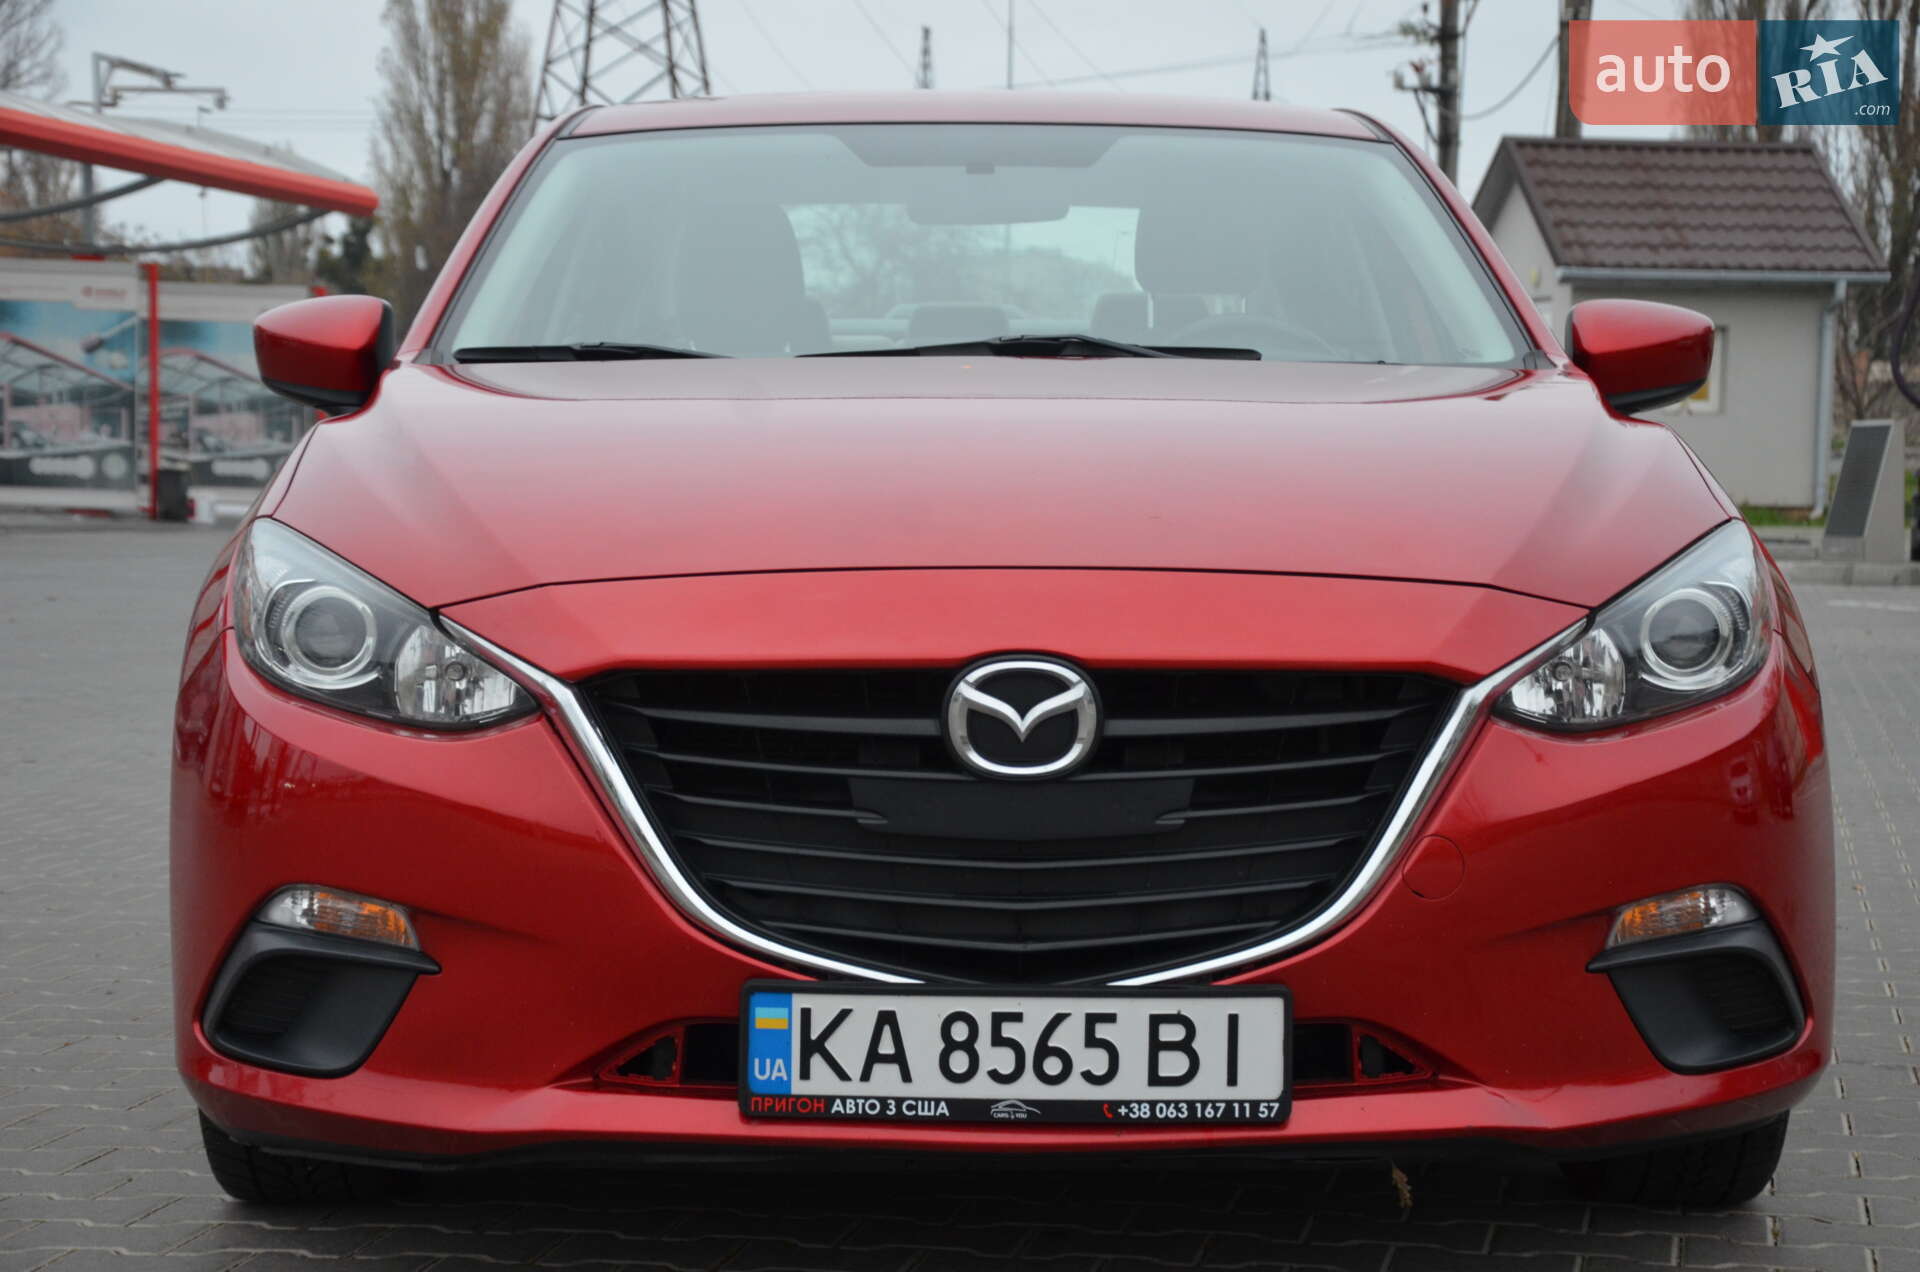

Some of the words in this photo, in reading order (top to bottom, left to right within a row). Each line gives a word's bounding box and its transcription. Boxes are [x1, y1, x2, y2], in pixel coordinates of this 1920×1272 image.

[799, 1007, 913, 1084] KA
[938, 1010, 1120, 1086] 8565
[753, 1057, 788, 1082] UA
[750, 1096, 826, 1113] ПРИГОН
[830, 1098, 881, 1114] АВТО
[902, 1099, 950, 1117] США
[1117, 1102, 1151, 1119] +38
[1155, 1102, 1189, 1119] 063
[1195, 1102, 1226, 1119] 167
[1232, 1102, 1251, 1119] 11
[1257, 1102, 1281, 1119] 57
